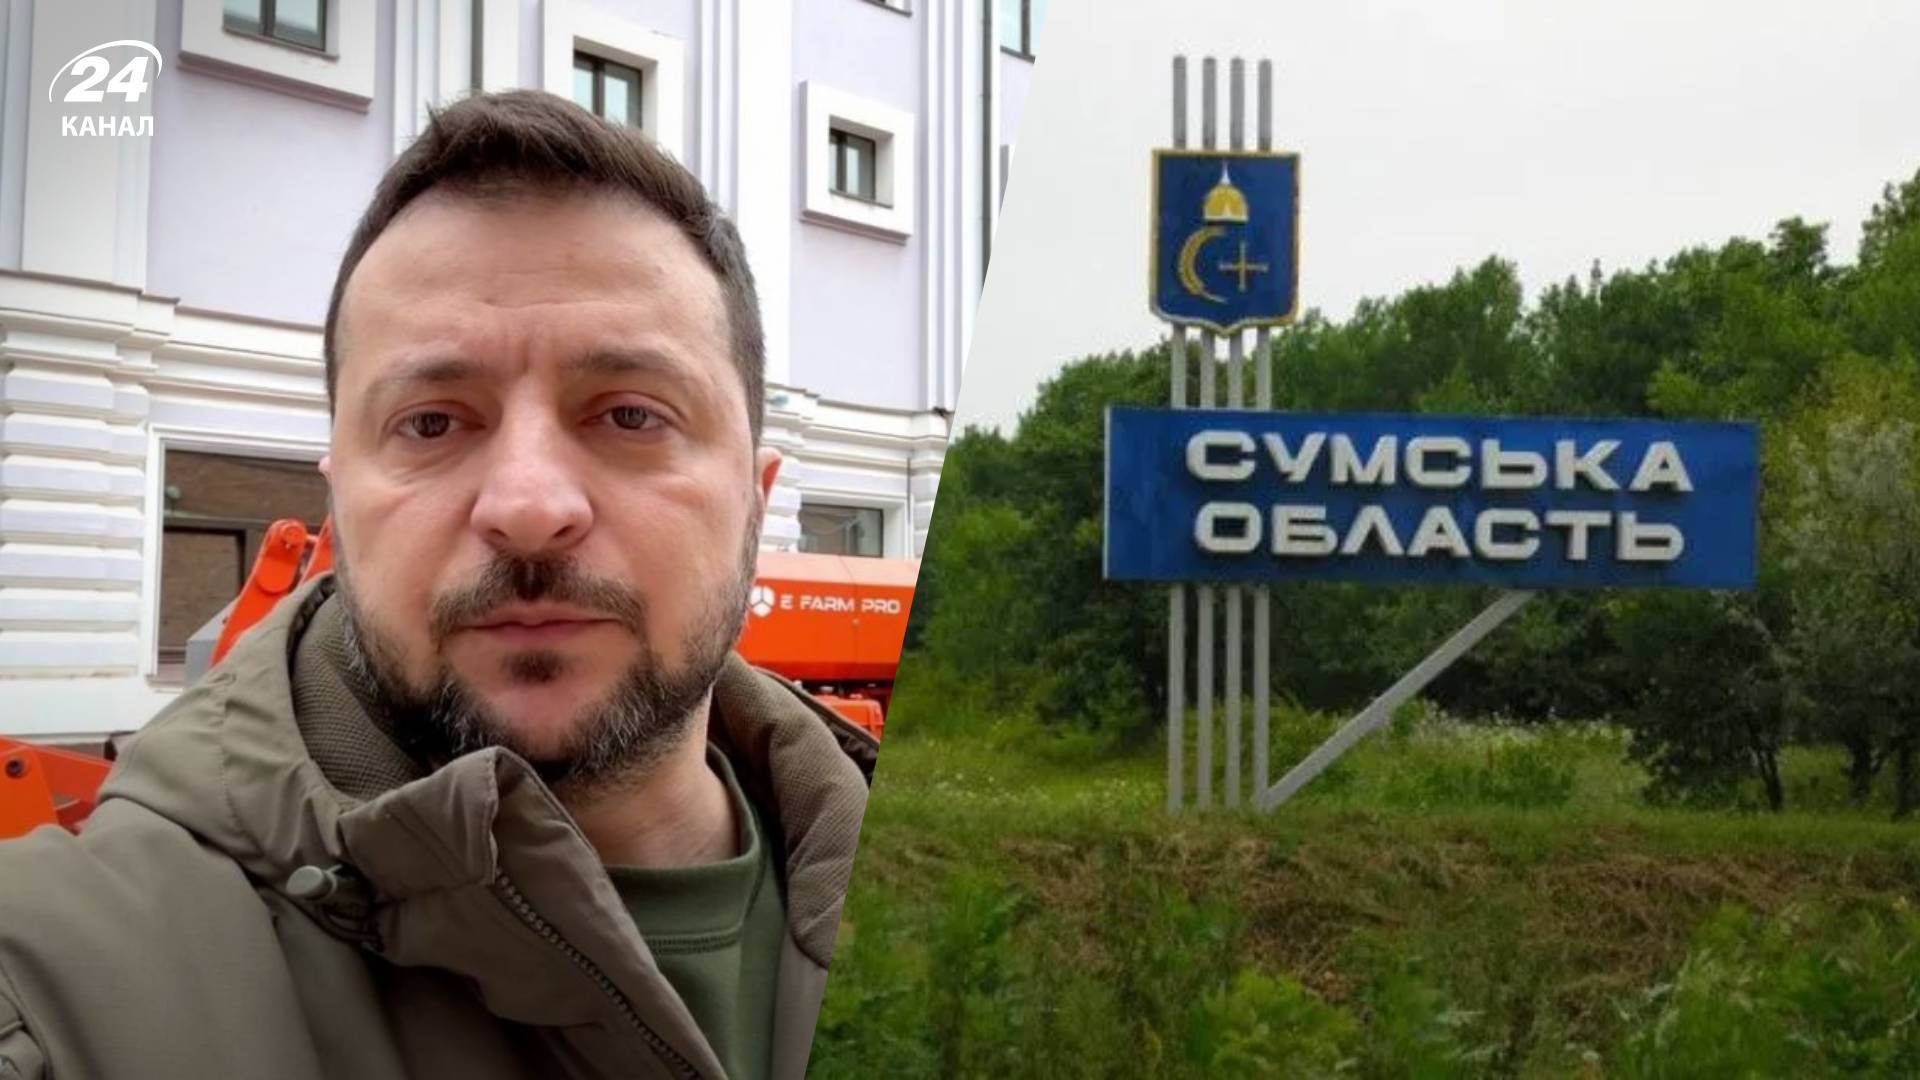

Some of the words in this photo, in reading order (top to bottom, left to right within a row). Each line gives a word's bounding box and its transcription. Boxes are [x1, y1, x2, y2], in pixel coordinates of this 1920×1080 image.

[1186, 430, 1694, 492] СУМСЬКА
[1193, 501, 1685, 562] ОБЛАСТЬ
[800, 595, 855, 612] FARM
[861, 598, 901, 614] PRO
